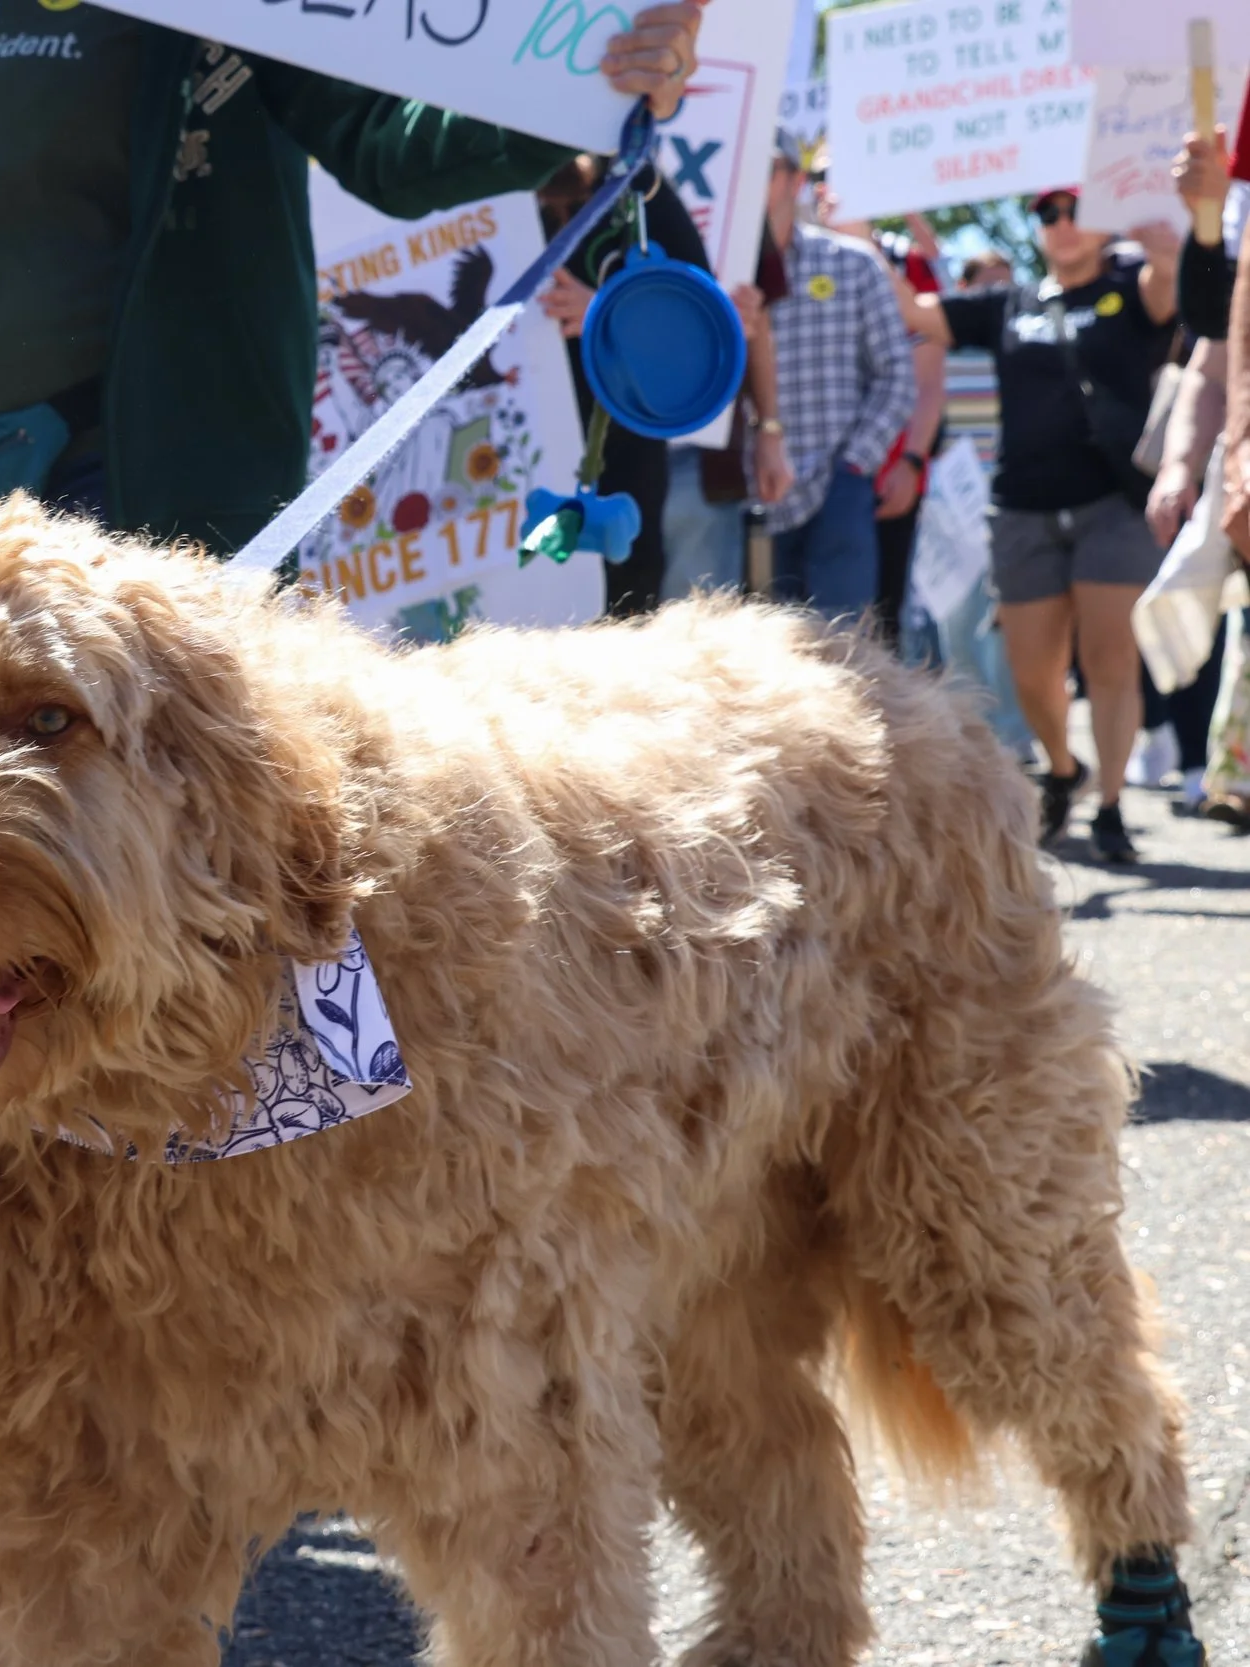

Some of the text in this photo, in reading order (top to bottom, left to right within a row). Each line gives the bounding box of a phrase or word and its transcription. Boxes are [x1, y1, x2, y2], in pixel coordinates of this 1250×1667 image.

[863, 15, 938, 50] NEED
[948, 5, 984, 33] TO
[906, 52, 941, 77] TO
[955, 38, 1018, 70] TELL
[855, 63, 1099, 124] GRANDCHILDREN
[888, 123, 935, 156] DID
[954, 110, 1009, 142] NOT
[1024, 100, 1088, 132] STAY
[932, 144, 1021, 185] SILENT
[317, 205, 498, 304] CTING KINGS
[437, 497, 520, 566] 177
